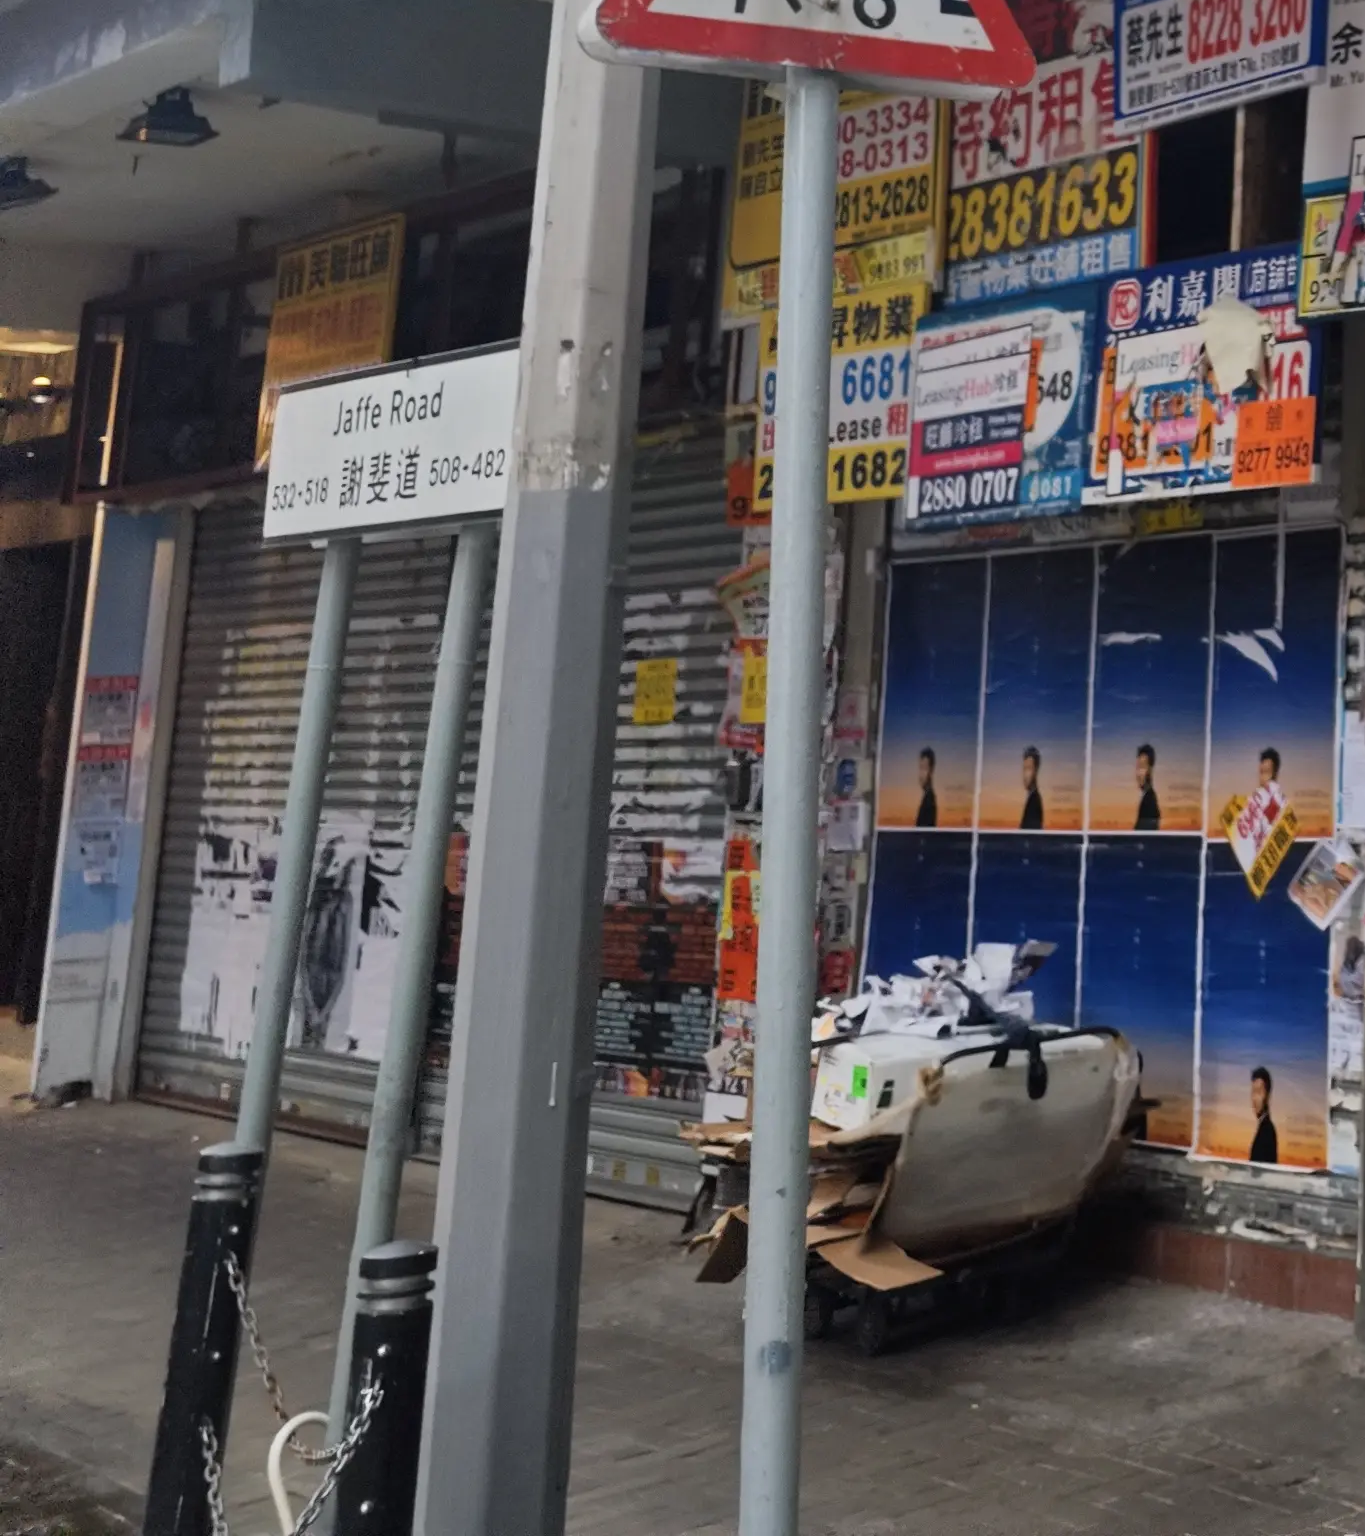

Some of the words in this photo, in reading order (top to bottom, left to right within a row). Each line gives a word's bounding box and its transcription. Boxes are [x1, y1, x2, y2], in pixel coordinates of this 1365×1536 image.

[837, 131, 929, 179] 8-0313
[841, 350, 912, 405] 6681
[333, 393, 382, 436] Jaffe
[390, 381, 445, 425] Road
[339, 445, 421, 508] 謝斐道
[833, 448, 907, 492] 1682
[1236, 446, 1271, 474] 9277
[1275, 441, 1311, 470] 9943
[920, 474, 967, 513] 2880
[970, 466, 1019, 506] 0707
